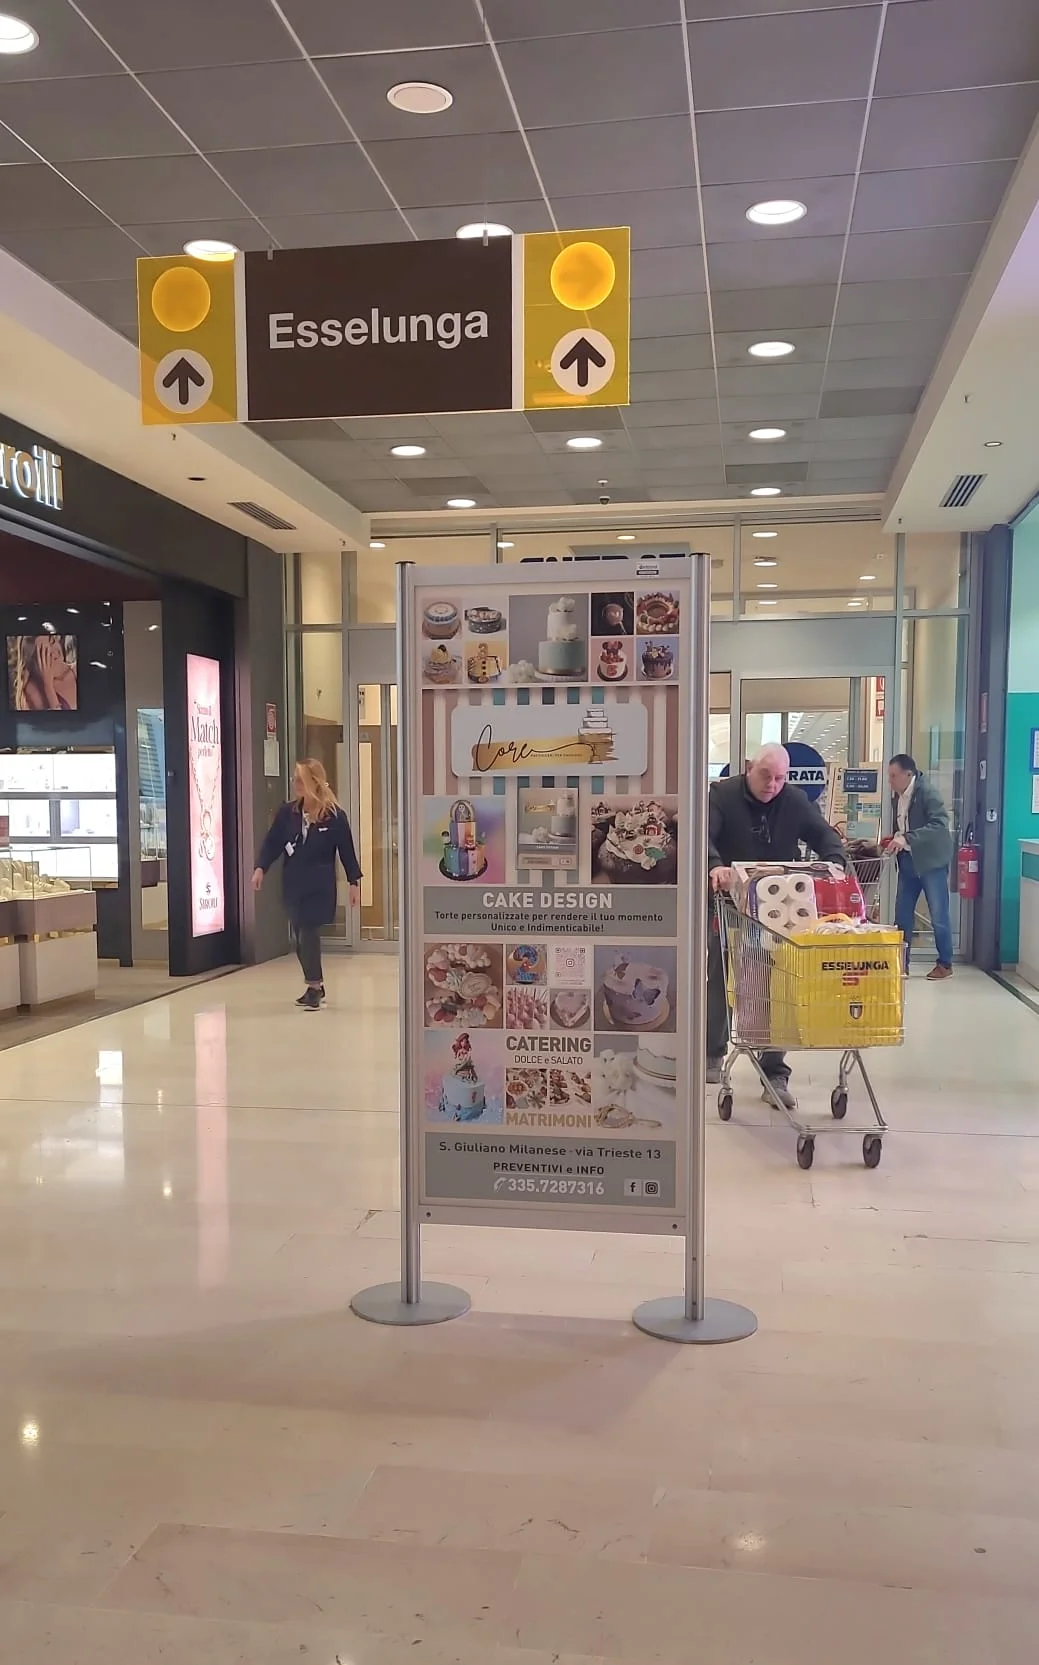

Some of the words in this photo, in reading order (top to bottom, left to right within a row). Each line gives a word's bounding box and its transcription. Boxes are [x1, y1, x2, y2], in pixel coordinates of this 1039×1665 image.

[269, 307, 489, 350] Esselunga
[0, 443, 63, 511] roili
[191, 716, 219, 744] Match
[788, 770, 825, 781] RATA
[482, 892, 534, 908] CAKE
[540, 892, 613, 909] DESIGN
[435, 911, 459, 920] Torte
[461, 911, 530, 921] personalizzate
[532, 913, 548, 922] per
[550, 913, 588, 921] rendere
[591, 912, 597, 921] il
[600, 913, 616, 921] tuo
[618, 913, 663, 922] momento
[491, 923, 517, 932] Unico
[527, 923, 605, 933] Indimenticabile!
[821, 961, 889, 971] ESSELUNGA
[506, 1035, 592, 1053] CATERING
[514, 1055, 543, 1064] DOLCE
[551, 1055, 584, 1065] SALATO
[506, 1112, 592, 1129] MATRIMONI
[439, 1141, 451, 1152] S.
[454, 1142, 506, 1154] Giuliano
[509, 1144, 567, 1156] Milanese
[575, 1146, 594, 1157] via
[597, 1147, 643, 1159] Trieste
[646, 1149, 662, 1160] 13
[493, 1162, 563, 1174] PREVENTIVI
[566, 1166, 573, 1174] e
[577, 1165, 605, 1175] INFO
[508, 1178, 605, 1196] 335.7287316
